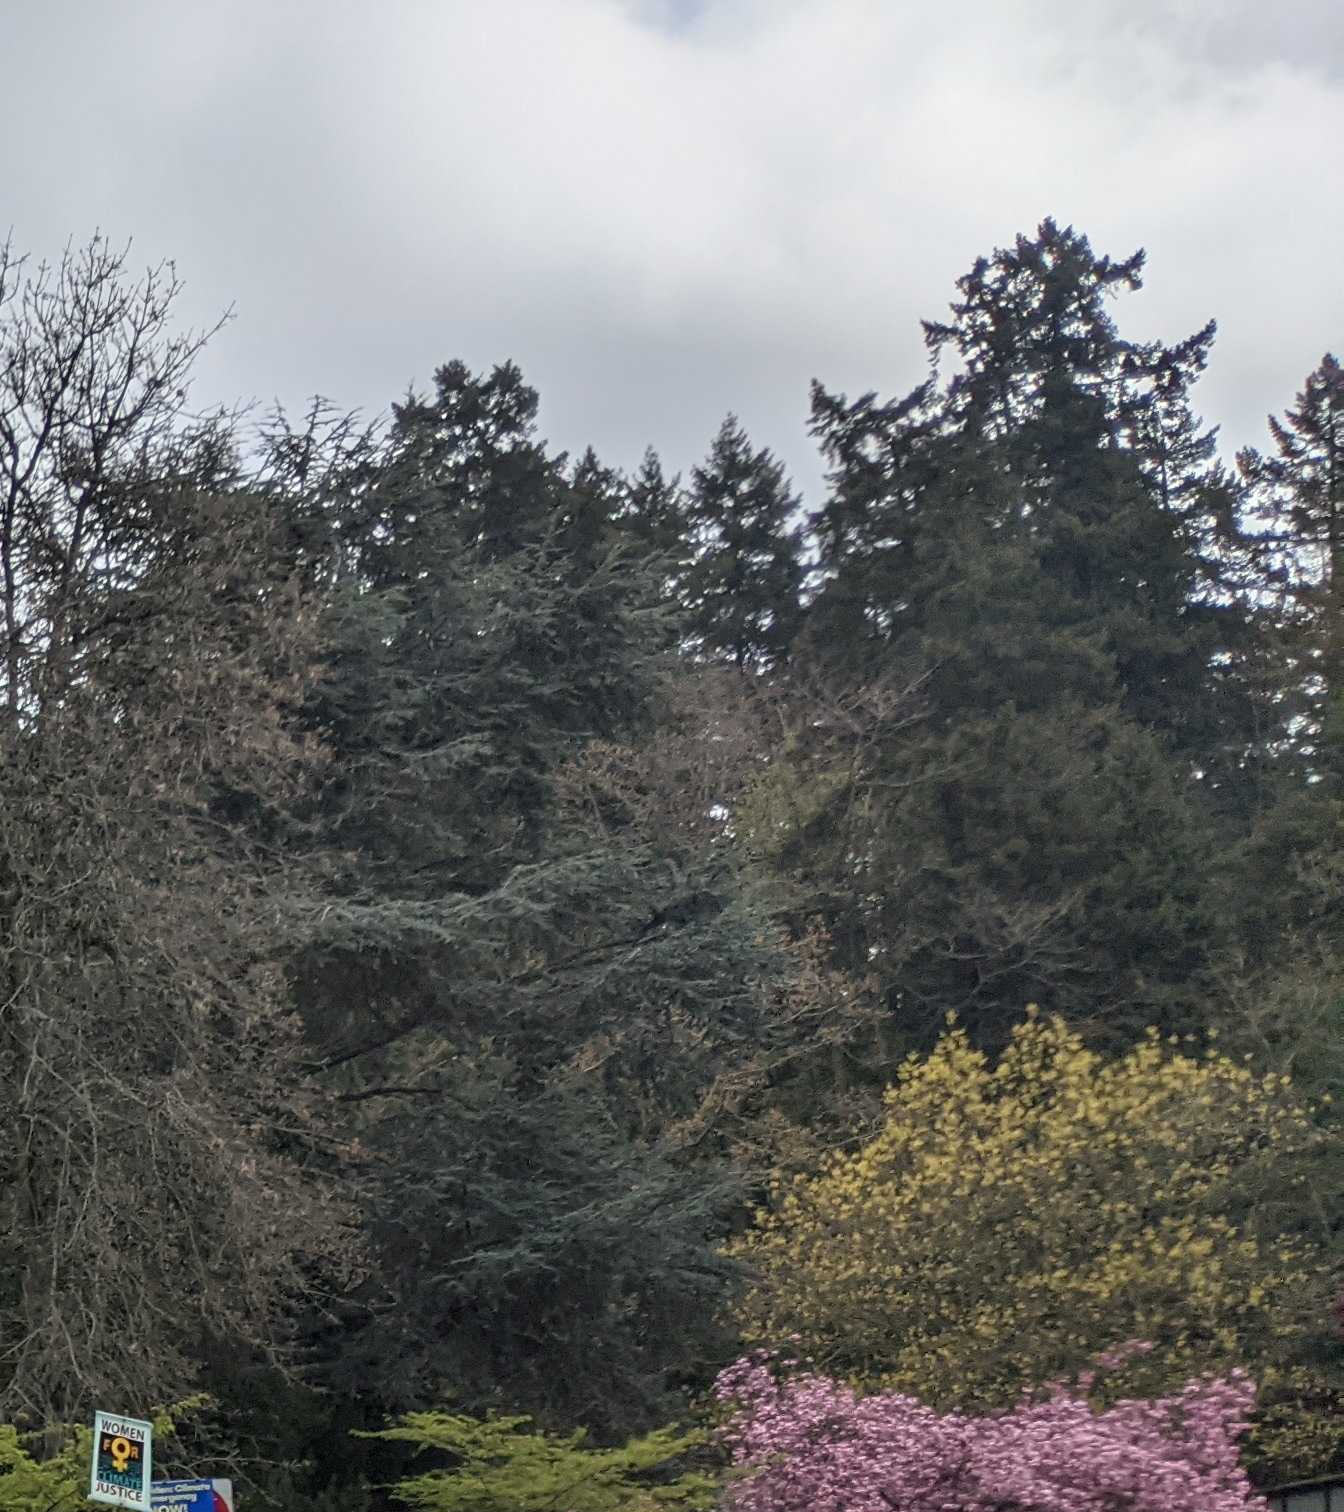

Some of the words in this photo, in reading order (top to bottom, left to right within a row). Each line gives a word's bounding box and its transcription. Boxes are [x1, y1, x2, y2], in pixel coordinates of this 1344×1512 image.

[101, 1418, 145, 1441] WOMEN
[98, 1470, 143, 1491] CLIMATE
[96, 1481, 143, 1503] JUSTICE
